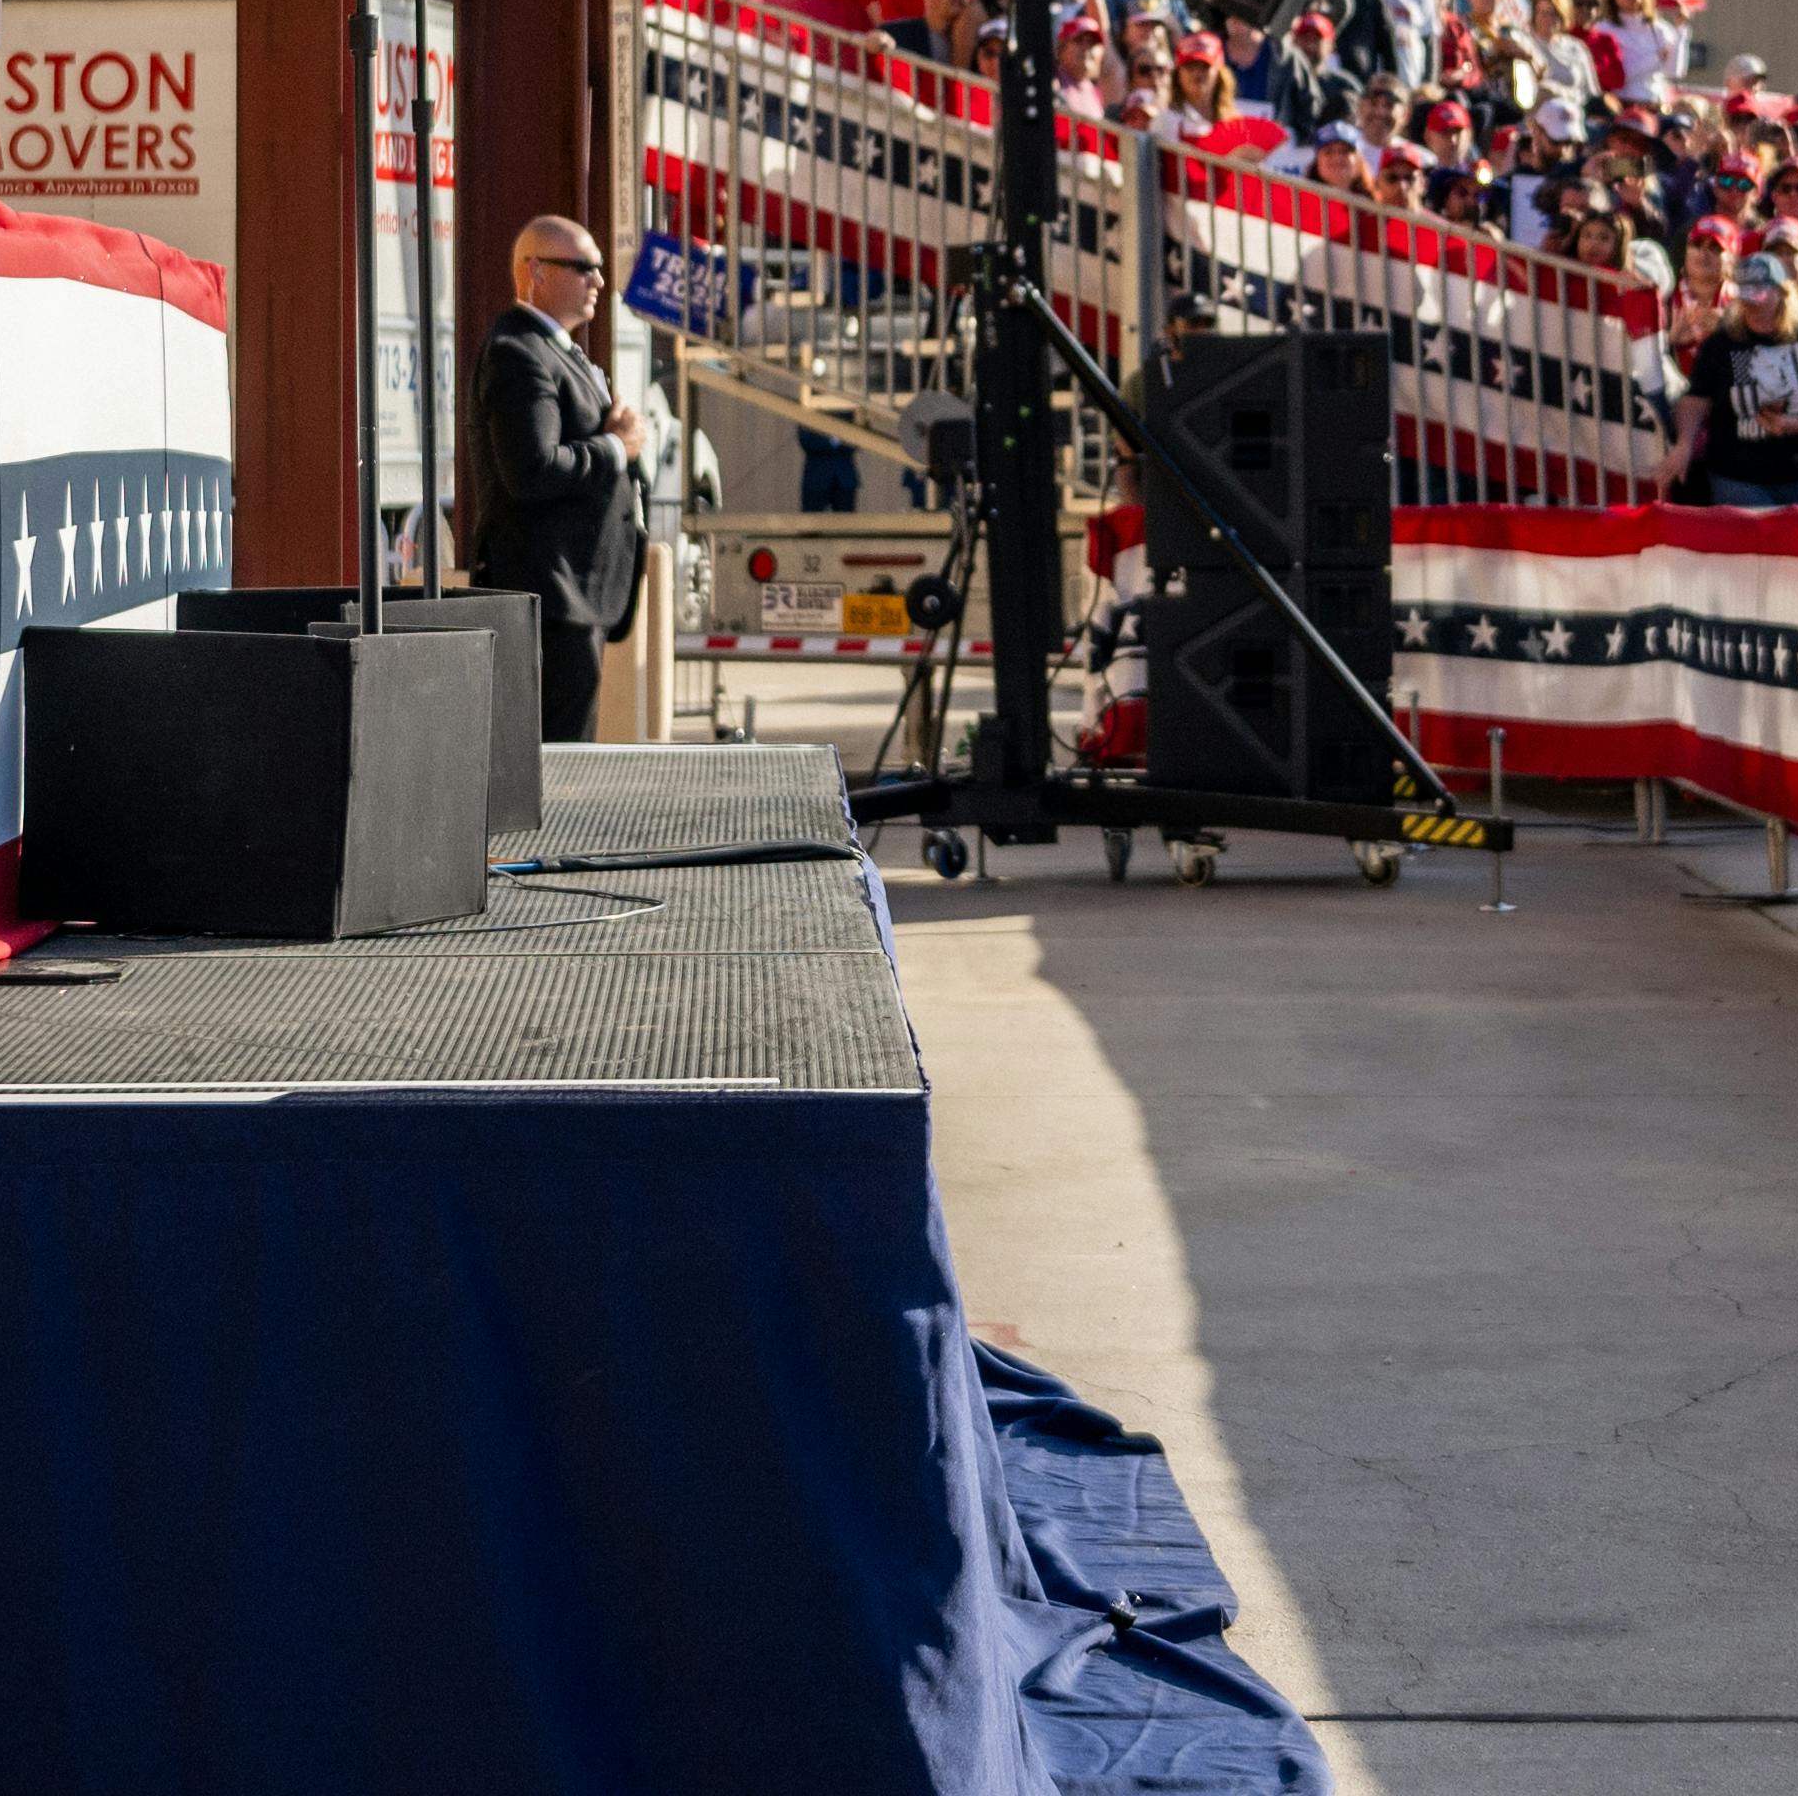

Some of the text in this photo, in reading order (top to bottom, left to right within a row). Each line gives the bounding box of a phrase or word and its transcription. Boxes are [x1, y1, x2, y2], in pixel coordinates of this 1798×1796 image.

[45, 178, 125, 196] Anywhere
[130, 178, 146, 194] In
[149, 178, 195, 195] Texas
